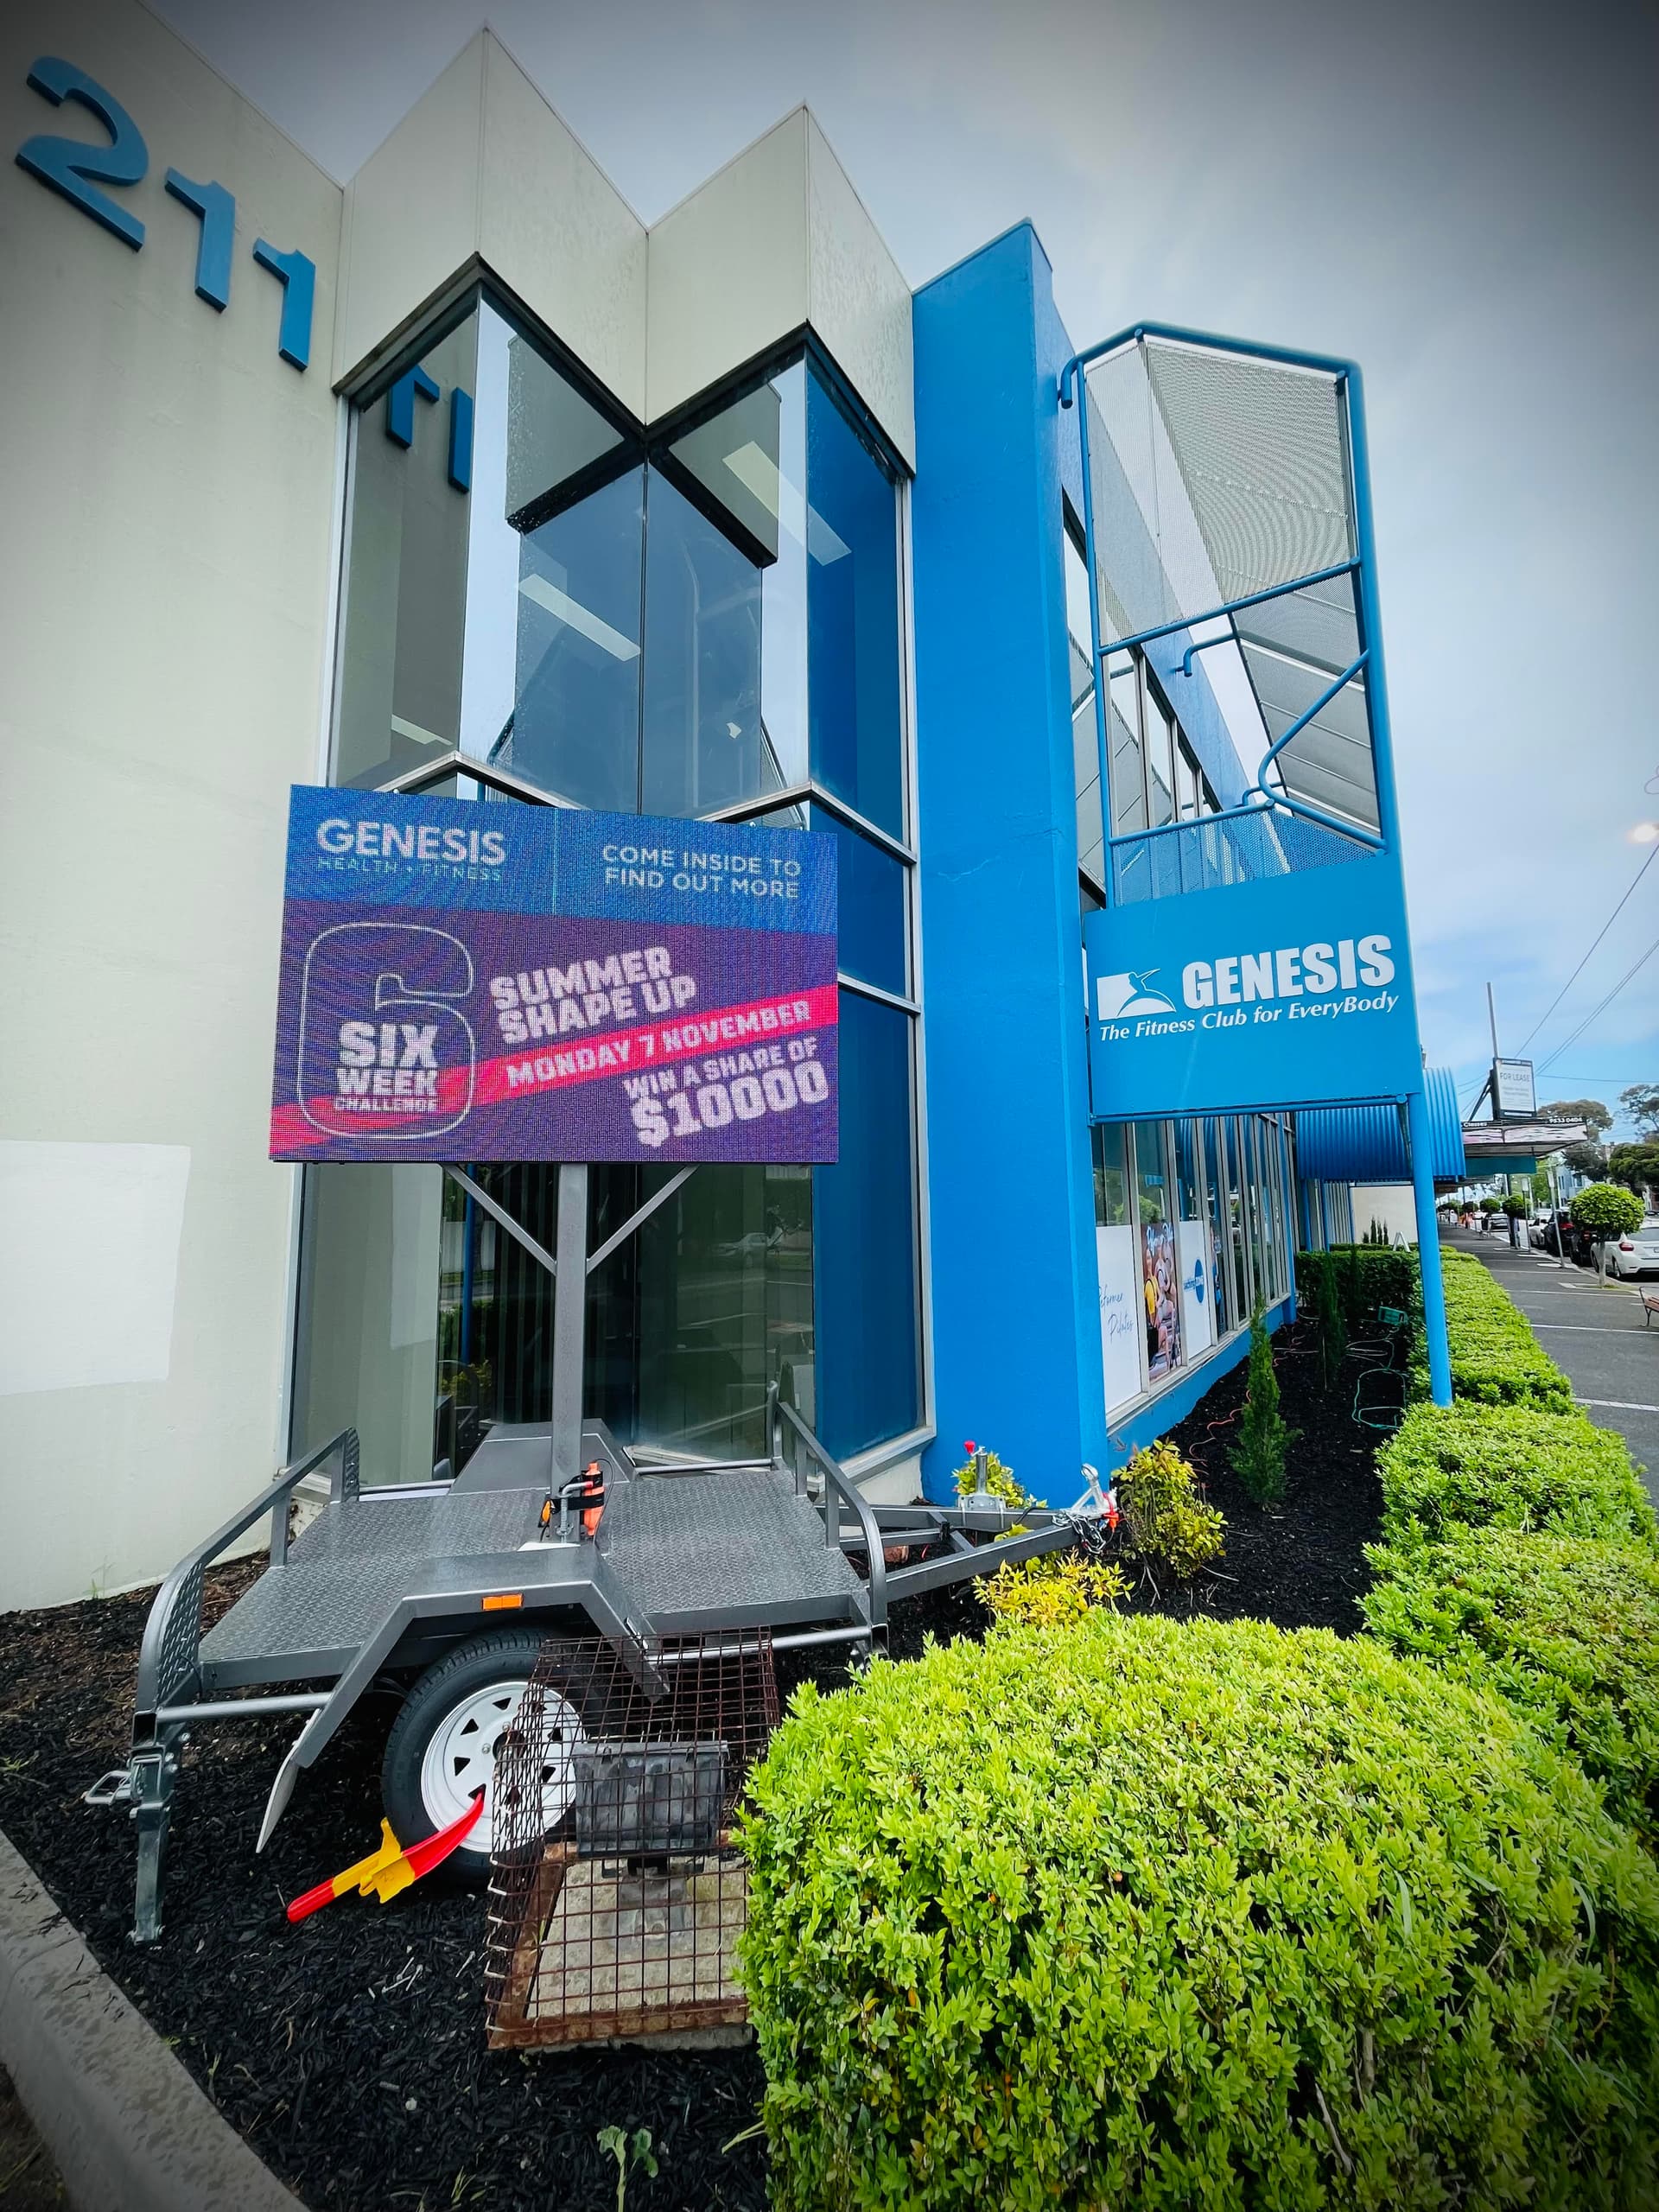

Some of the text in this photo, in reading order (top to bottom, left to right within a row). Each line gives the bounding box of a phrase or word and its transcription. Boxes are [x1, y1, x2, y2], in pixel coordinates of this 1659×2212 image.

[13, 55, 316, 372] 211
[317, 818, 506, 865] GENESIS
[602, 844, 801, 877] COME INSIDE TO
[318, 856, 397, 873] HEALTH
[423, 862, 501, 880] FITNESS
[605, 868, 799, 899] FIND OUT MORE
[489, 946, 674, 1010] SUMMER
[1182, 934, 1395, 1009] GENESIS
[498, 975, 696, 1044] SHAPE UP
[1100, 991, 1400, 1041] The Fitness Club for EveryBody
[339, 1020, 438, 1068] SIX
[505, 1001, 811, 1087] MONDAY 7 NOVEMBER
[623, 1037, 818, 1099] WIN A SHARE OF
[336, 1068, 438, 1096] WEEK
[1512, 1073, 1530, 1082] LEASE
[334, 1096, 438, 1112] CHALLENGE
[631, 1061, 830, 1147] $10000
